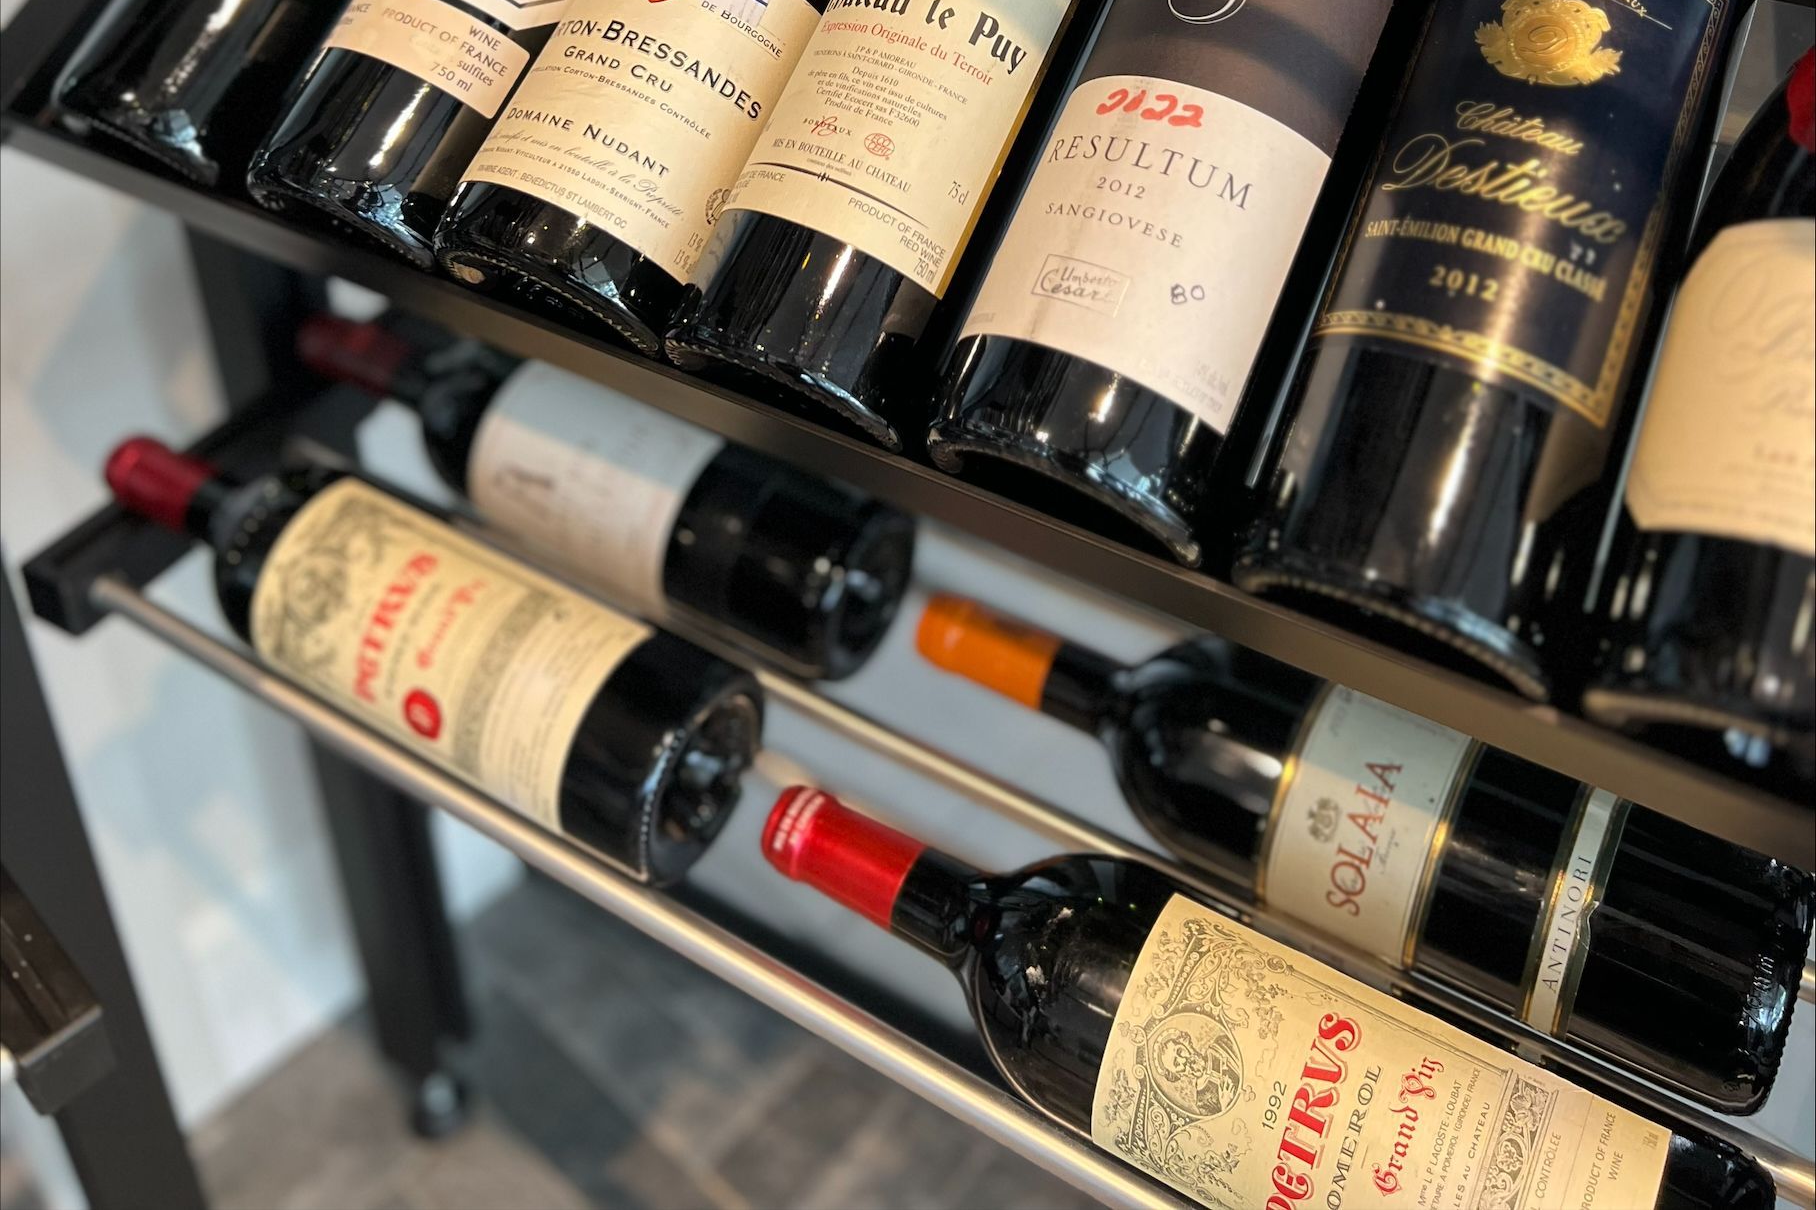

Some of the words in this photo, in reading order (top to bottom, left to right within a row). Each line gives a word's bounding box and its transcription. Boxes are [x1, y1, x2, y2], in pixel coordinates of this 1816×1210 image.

[381, 7, 439, 35] PRODUCT
[438, 30, 459, 46] OF
[459, 41, 508, 78] FRANCE
[468, 25, 502, 51] WINE
[700, 0, 718, 12] DE
[719, 9, 784, 58] BOURGOGNE
[820, 19, 869, 35] Expression
[871, 22, 928, 52] Originale
[930, 43, 949, 61] du
[951, 50, 995, 87] Terroir
[967, 10, 1030, 76] Puy
[429, 61, 456, 82] 750
[456, 78, 474, 93] ml
[456, 60, 495, 87] sulfites
[556, 19, 763, 120] RTON-BRESSANDES
[563, 44, 621, 70] GRAND
[630, 63, 674, 93] CRU
[851, 65, 879, 81] Depuis
[880, 75, 899, 87] 1610
[898, 65, 934, 87] GIRONDE
[938, 84, 969, 106] FRANCE
[563, 65, 657, 106] CORTON-BRESSANDES
[659, 101, 713, 140] CONTRÔLÉE
[824, 96, 853, 113] Produit
[853, 105, 864, 116] de
[864, 108, 894, 128] France
[828, 71, 837, 79] en
[862, 78, 874, 89] vin
[874, 83, 887, 94] est
[887, 88, 904, 100] issu
[904, 93, 916, 105] de
[916, 99, 949, 122] cultures
[834, 82, 881, 102] vinifications
[881, 96, 922, 119] naturelles
[844, 92, 875, 110] Ecocert
[875, 102, 887, 115] sas
[888, 107, 921, 128] F32600
[506, 106, 575, 131] DOMAINE
[582, 123, 670, 178] NUDANT
[1456, 100, 1585, 156] Château
[756, 170, 787, 183] FRANCE
[784, 139, 796, 151] EN
[798, 140, 847, 164] BOUTEILLE
[849, 157, 864, 171] AU
[865, 164, 911, 194] CHATEAU
[1047, 133, 1255, 212] RESULTUM
[1095, 175, 1147, 200] 2012
[1381, 132, 1628, 243] Destieux
[519, 172, 566, 197] BENEDICTUS
[577, 196, 616, 222] LAMBERT
[847, 196, 898, 228] PRODUCT
[897, 221, 913, 235] OF
[911, 229, 947, 260] FRANCE
[1044, 201, 1185, 249] SANGIOVESE
[1364, 216, 1461, 244] SAINT-ÉMILION
[1461, 227, 1521, 260] GRAND
[1519, 246, 1558, 275] CRU
[899, 235, 920, 253] RED
[920, 246, 943, 269] WINE
[1428, 264, 1500, 303] 2012
[1324, 760, 1404, 919] SOLAIA
[1541, 854, 1594, 994] ANTINORI
[1261, 1080, 1288, 1132] 1992
[1444, 1134, 1460, 1174] POMEROL
[1467, 1066, 1482, 1096] FRANCE
[1467, 1100, 1492, 1160] CHATEAU
[1599, 1110, 1618, 1144] FRANCE
[1325, 1064, 1384, 1210] OMEROL
[1371, 1102, 1420, 1198] Grand
[1597, 1143, 1608, 1162] OF
[1463, 1164, 1472, 1181] AU
[1579, 1158, 1600, 1210] RODUCT
[1607, 1150, 1625, 1183] WINE
